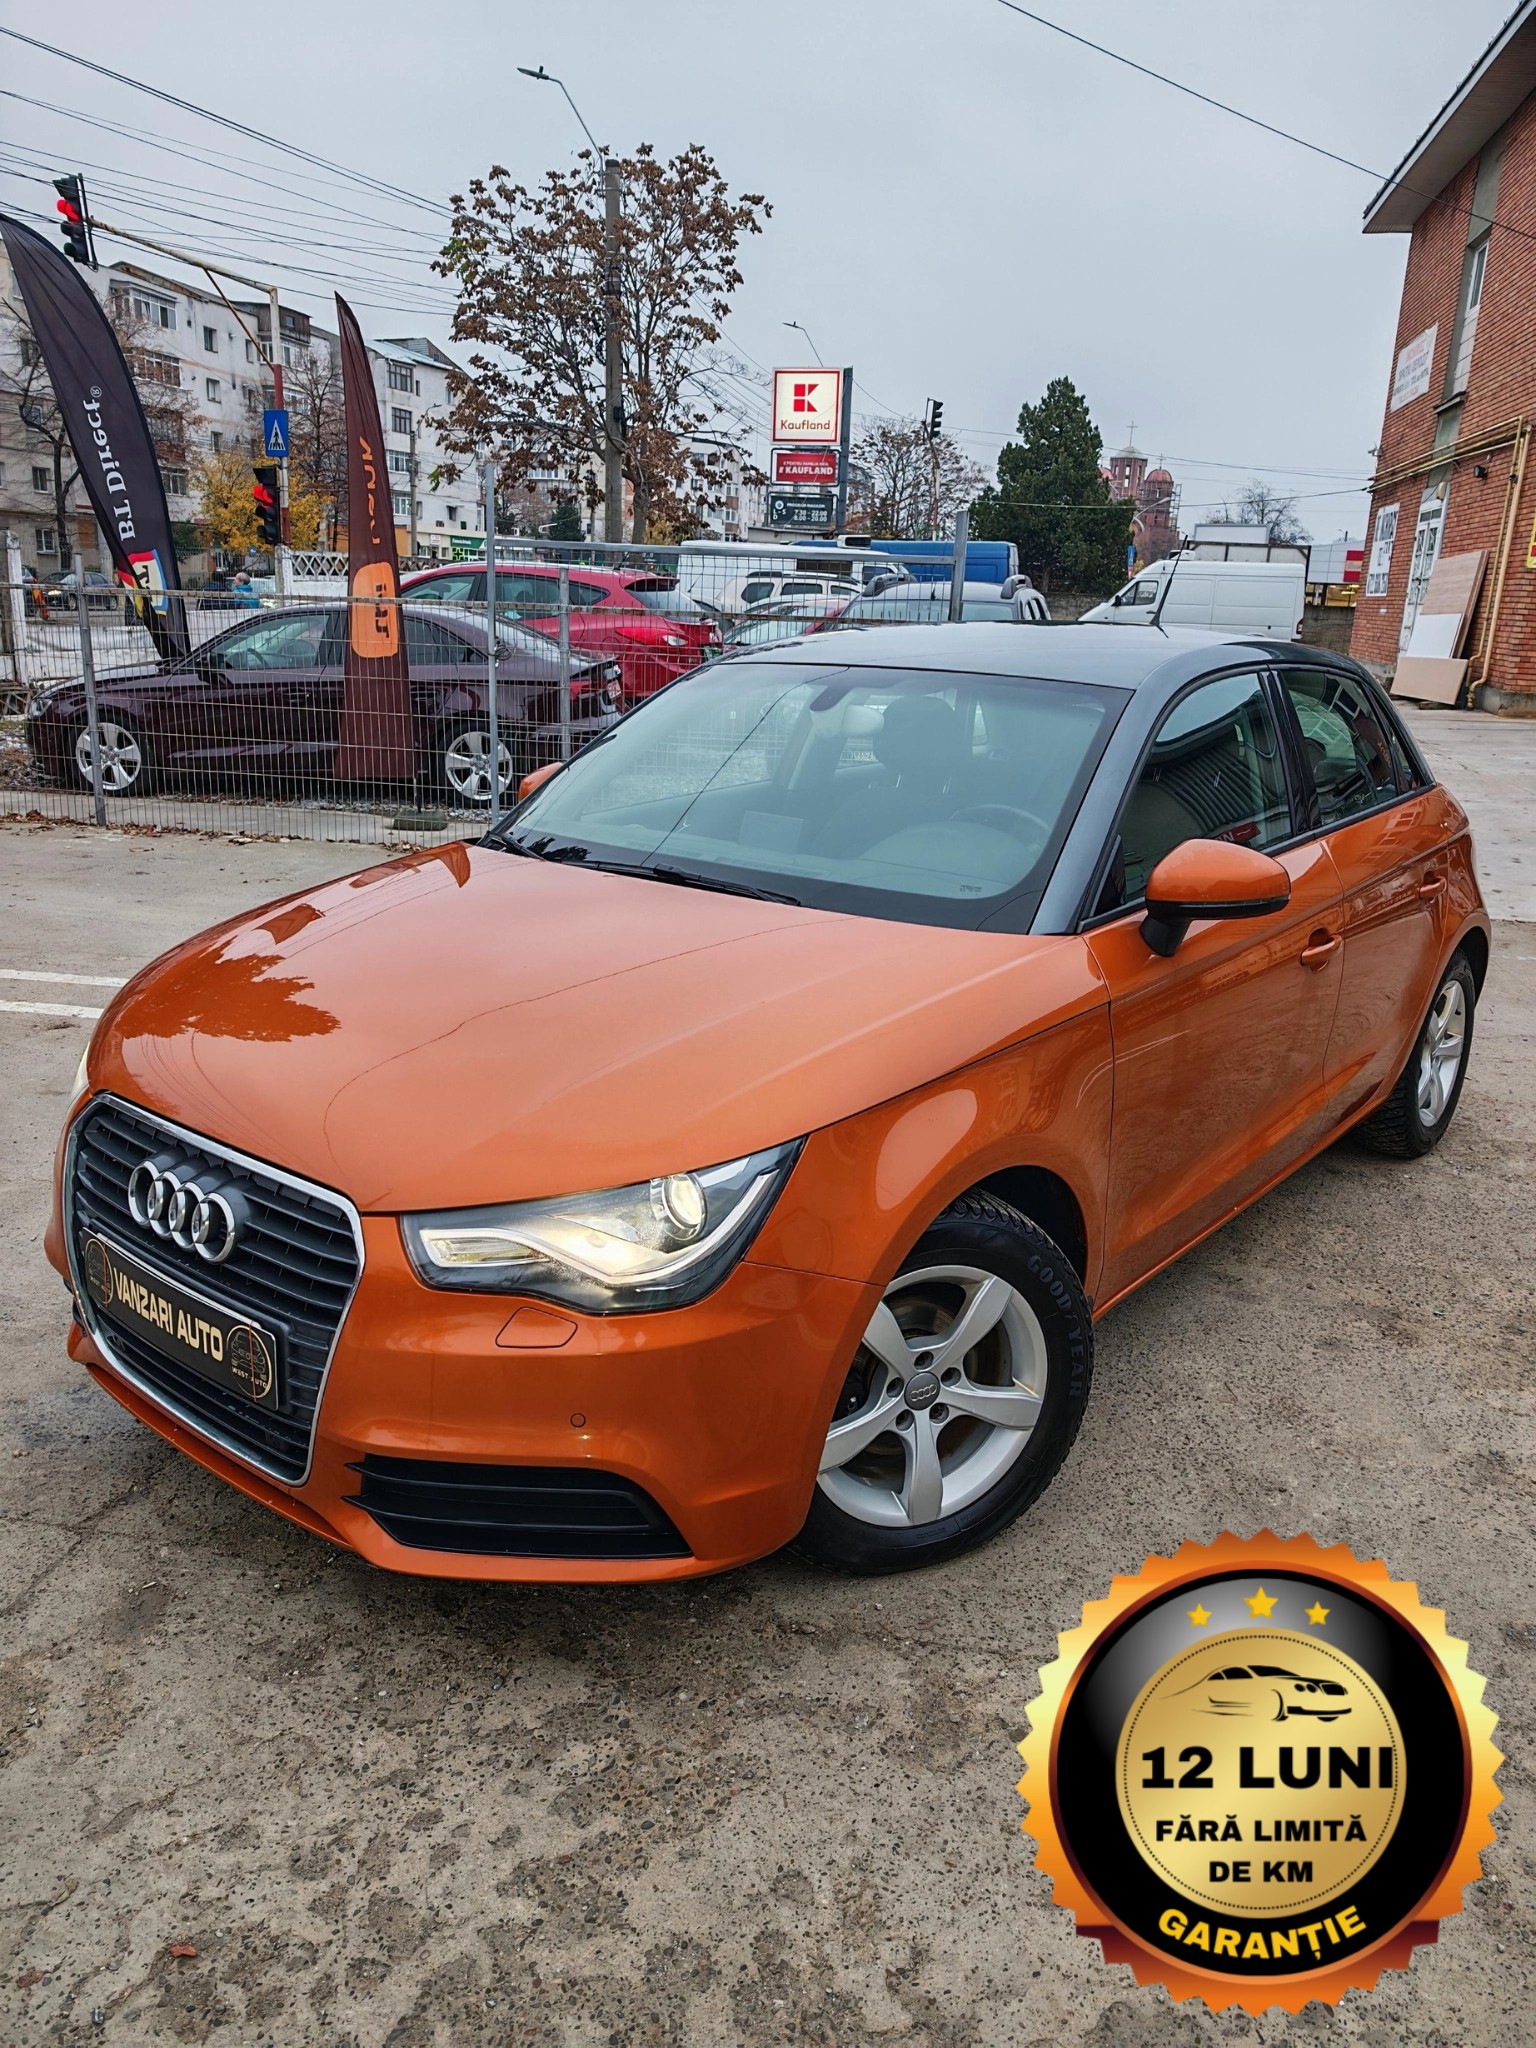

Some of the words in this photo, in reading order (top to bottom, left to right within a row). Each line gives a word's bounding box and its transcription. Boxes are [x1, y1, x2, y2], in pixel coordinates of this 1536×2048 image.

[780, 419, 831, 430] Kaufland
[785, 467, 834, 475] KAUFLAND
[113, 1267, 174, 1335] VANZARI
[177, 1309, 223, 1362] AUTO
